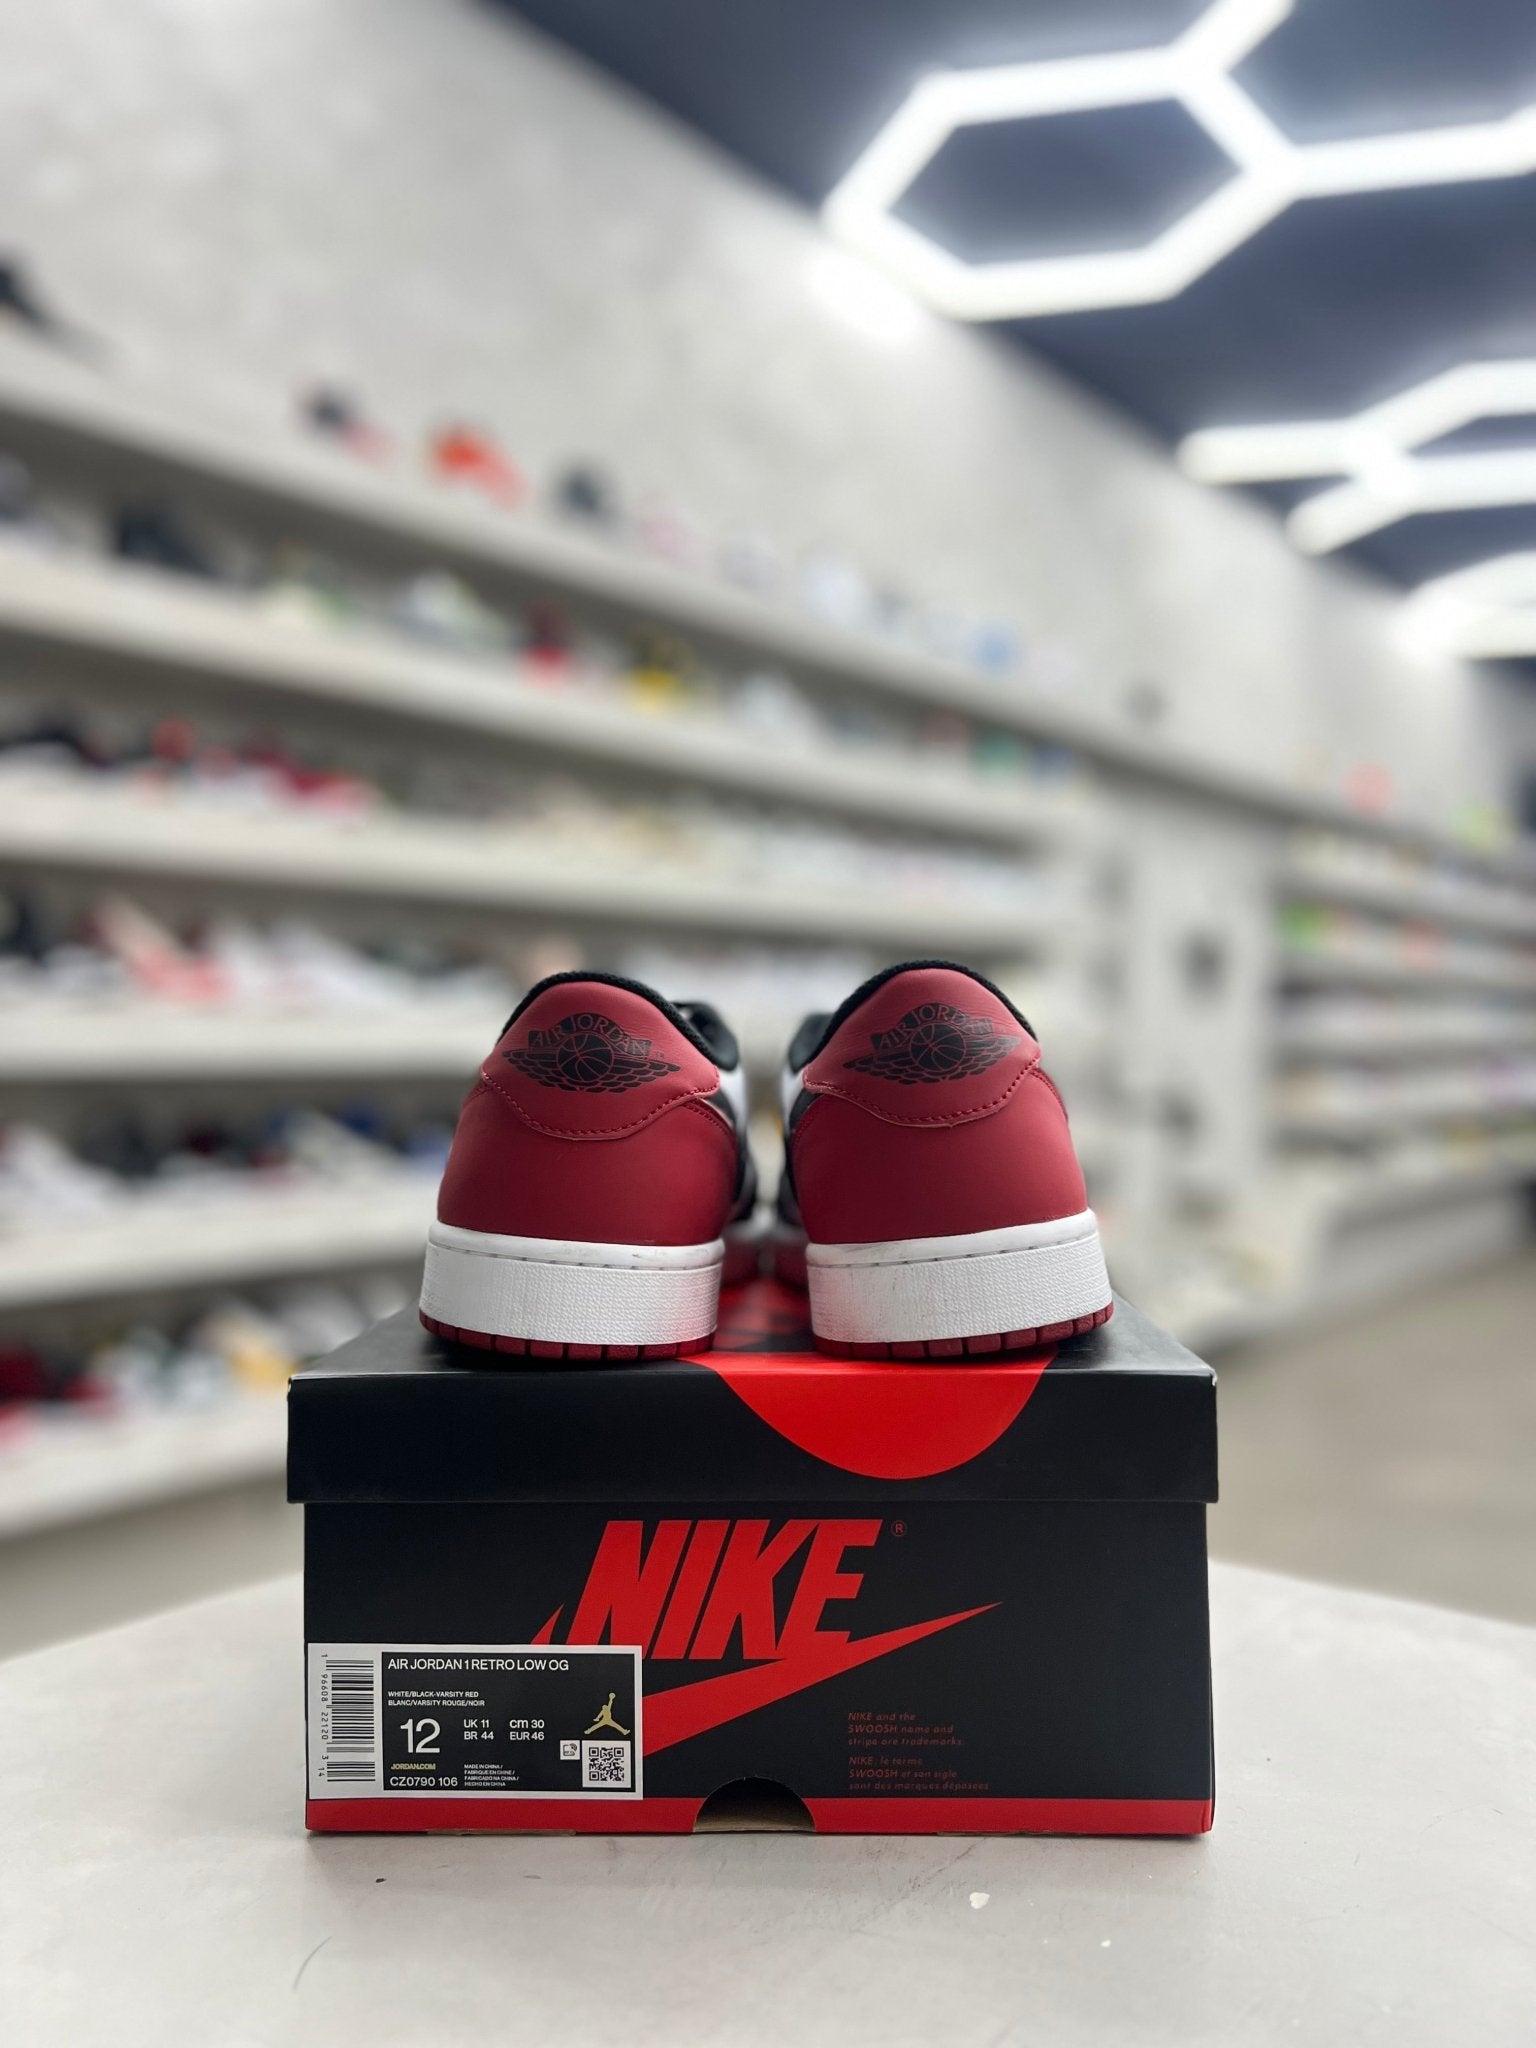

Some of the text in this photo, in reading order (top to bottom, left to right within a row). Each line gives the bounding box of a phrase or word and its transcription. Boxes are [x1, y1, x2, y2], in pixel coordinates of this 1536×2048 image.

[533, 1025, 566, 1048] AIR
[569, 1014, 648, 1056] JORDAN
[879, 1022, 912, 1049] AIR
[565, 1519, 883, 1660] NIKE
[387, 1658, 569, 1671] AIR JORDAN 1 RETRO LOW OG
[320, 1674, 328, 1702] 96608
[387, 1690, 464, 1698] WHITE/BLACK-VARSITY
[442, 1699, 485, 1707] ROUGE/NOIR
[848, 1712, 916, 1721] NIKE and the
[321, 1712, 329, 1740] 22120
[463, 1719, 490, 1729] UK 11
[530, 1719, 545, 1729] 30
[848, 1724, 898, 1733] SWOOSH
[933, 1725, 955, 1733] and
[400, 1718, 441, 1754] 12
[463, 1731, 495, 1741] BR 44
[509, 1731, 545, 1741] EUR 46
[848, 1737, 878, 1747] stripe
[318, 1767, 326, 1777] 14
[390, 1763, 436, 1771] JORDAN.COM
[849, 1769, 897, 1778] SWOOSH
[389, 1776, 458, 1787] CZ0790 106
